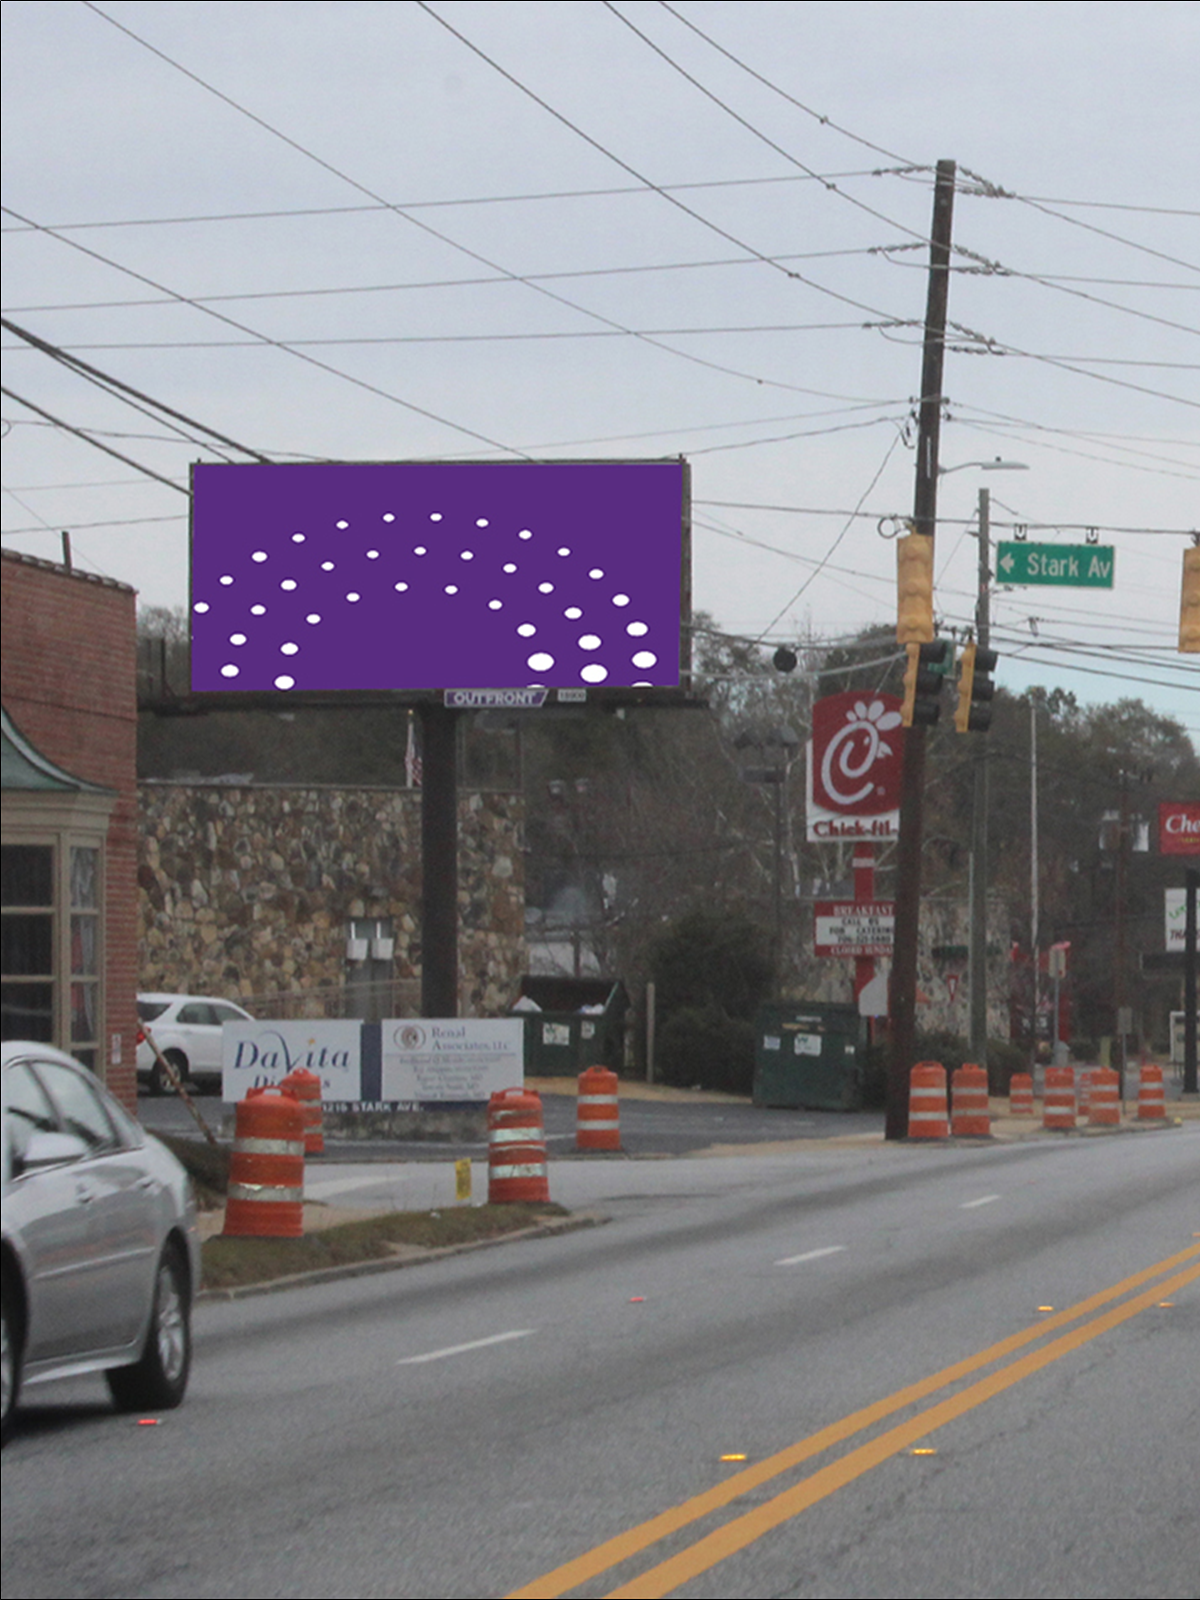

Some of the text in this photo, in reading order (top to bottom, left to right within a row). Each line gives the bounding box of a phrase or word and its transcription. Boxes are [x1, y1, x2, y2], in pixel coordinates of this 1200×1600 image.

[1027, 551, 1112, 579] Stark Av
[453, 691, 538, 705] OUTFRONT
[812, 820, 899, 837] Chick-fil-
[833, 904, 895, 917] BREAKFAST
[856, 926, 894, 935] CATERIN
[864, 946, 893, 955] SUNDA
[431, 1025, 466, 1039] Renal
[234, 1029, 350, 1075] DaVita
[352, 1101, 392, 1113] STARK
